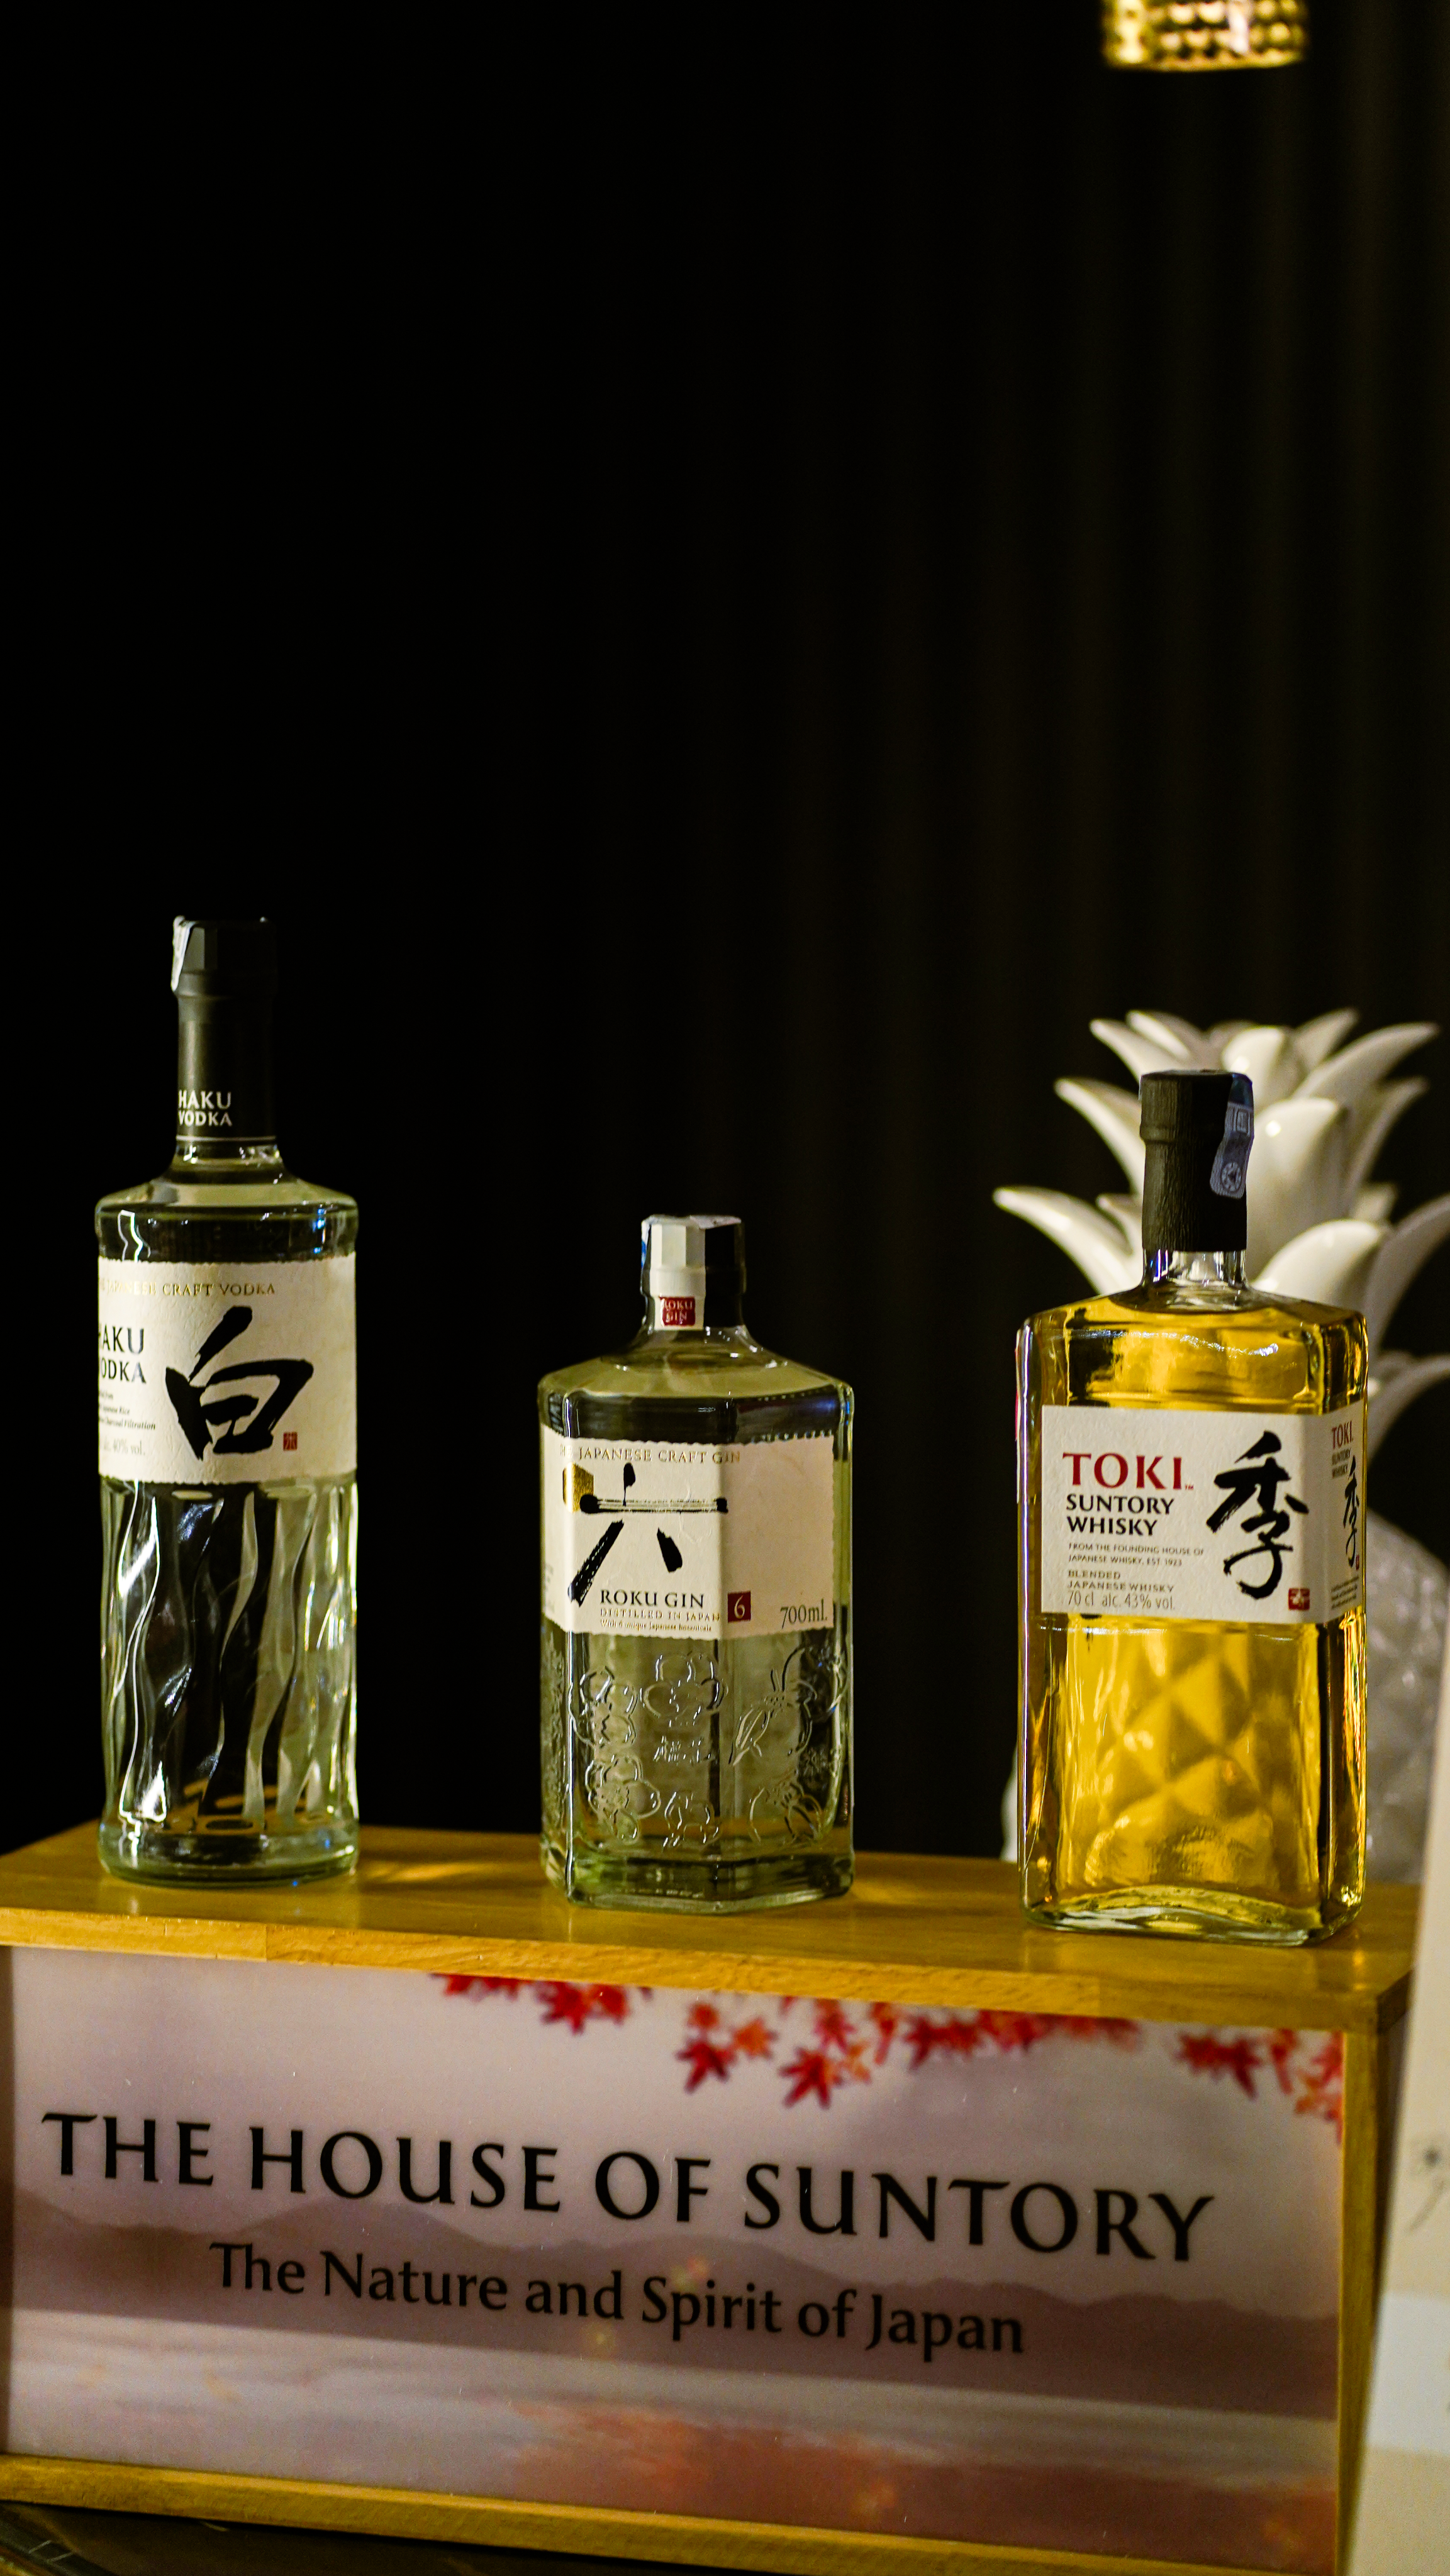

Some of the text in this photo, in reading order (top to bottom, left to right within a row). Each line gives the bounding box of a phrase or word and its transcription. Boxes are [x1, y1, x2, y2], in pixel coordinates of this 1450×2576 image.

[178, 1089, 231, 1109] HAKU
[178, 1110, 232, 1126] VODKA
[163, 1283, 214, 1296] CRAFT
[220, 1283, 276, 1296] VODKA
[101, 1357, 147, 1384] ODKA
[165, 1305, 314, 1461] 白
[579, 1446, 652, 1462] JAPANESE
[658, 1450, 708, 1464] CRAFT
[712, 1451, 741, 1465] GIN
[1066, 1493, 1175, 1516] SUNTORY
[1206, 1430, 1310, 1600] 季
[567, 1462, 728, 1606] 六
[1067, 1516, 1158, 1536] WHISKY
[1069, 1542, 1205, 1556] FROM THE FOUNDING HOUSE OF
[1069, 1555, 1107, 1563] JAPANESE
[1068, 1570, 1121, 1580] BLENDED
[1068, 1580, 1174, 1593] JAPANESE WHISKY
[600, 1589, 705, 1609] ROKU GIN
[733, 1594, 745, 1619] 6
[1068, 1590, 1176, 1610] 70 cl alc. 43% vol.
[600, 1607, 720, 1623] DISTILLED IN JAPAN
[780, 1598, 827, 1629] 700ml.
[600, 1618, 618, 1628] With
[625, 1621, 647, 1631] unique
[649, 1621, 677, 1632] Japanese
[679, 1623, 712, 1633] botanicals
[42, 2112, 1214, 2262] THE HOUSE OF SUNTORY
[209, 2241, 1023, 2364] The Nature and Spirit of Japan
